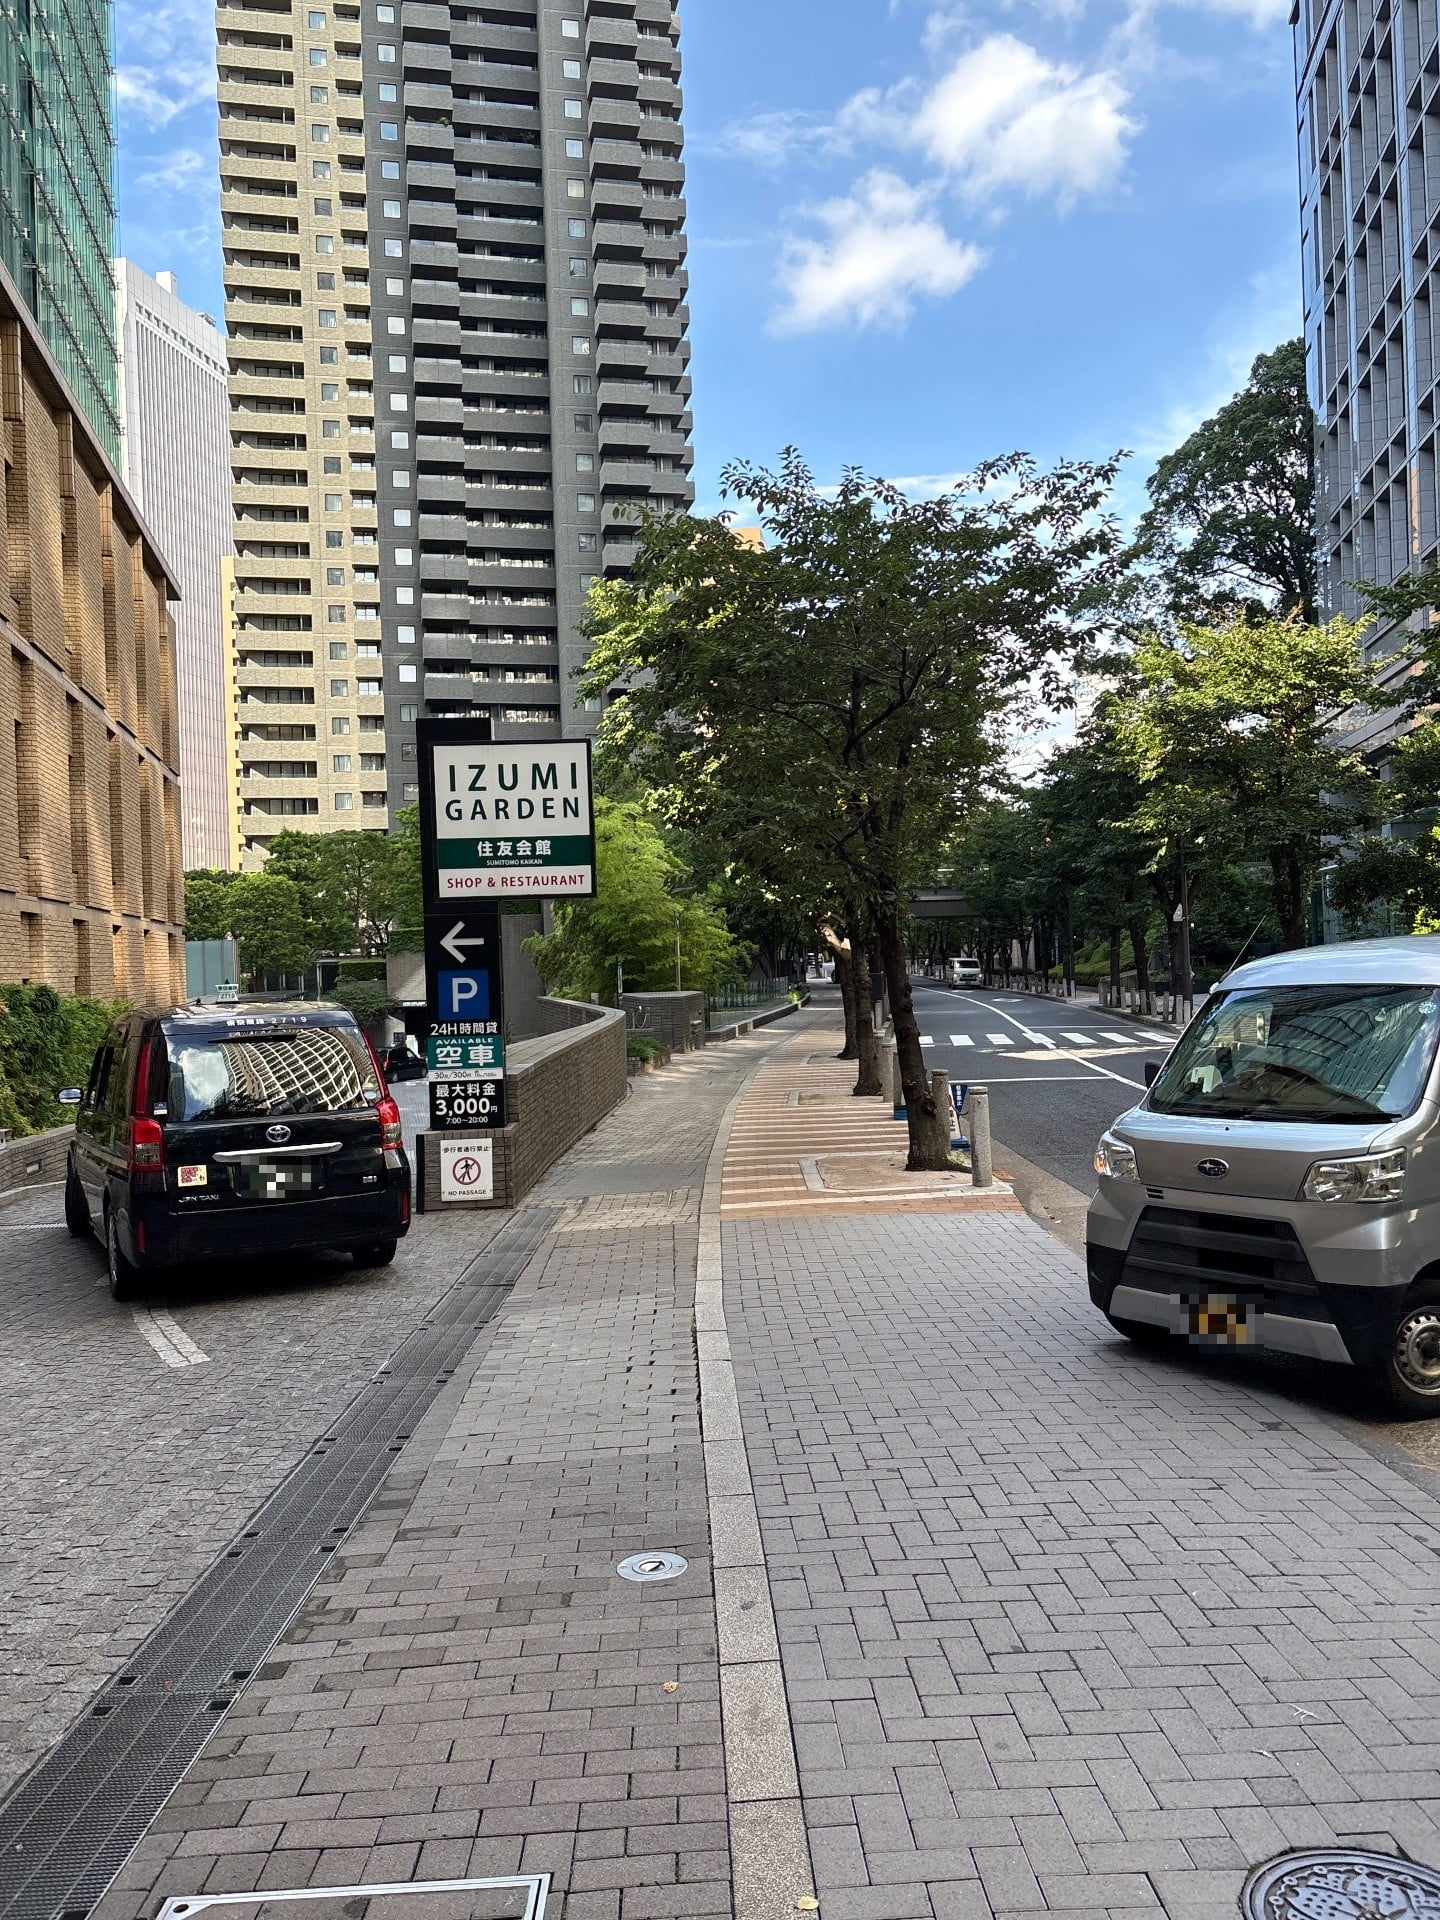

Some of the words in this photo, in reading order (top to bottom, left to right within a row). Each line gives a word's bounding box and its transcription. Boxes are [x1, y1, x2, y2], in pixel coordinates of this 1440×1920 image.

[448, 762, 578, 792] IZUMI
[445, 796, 580, 821] GARDEN
[477, 839, 552, 857] 住友会館
[447, 876, 482, 889] SHOP
[487, 876, 496, 888] &
[501, 874, 585, 887] RESTAURANT
[451, 977, 478, 1013] P
[436, 1037, 494, 1046] AVAILABLE
[435, 1044, 495, 1068] 空車
[436, 1082, 496, 1098] 最大料金
[435, 1098, 498, 1117] 3,000円
